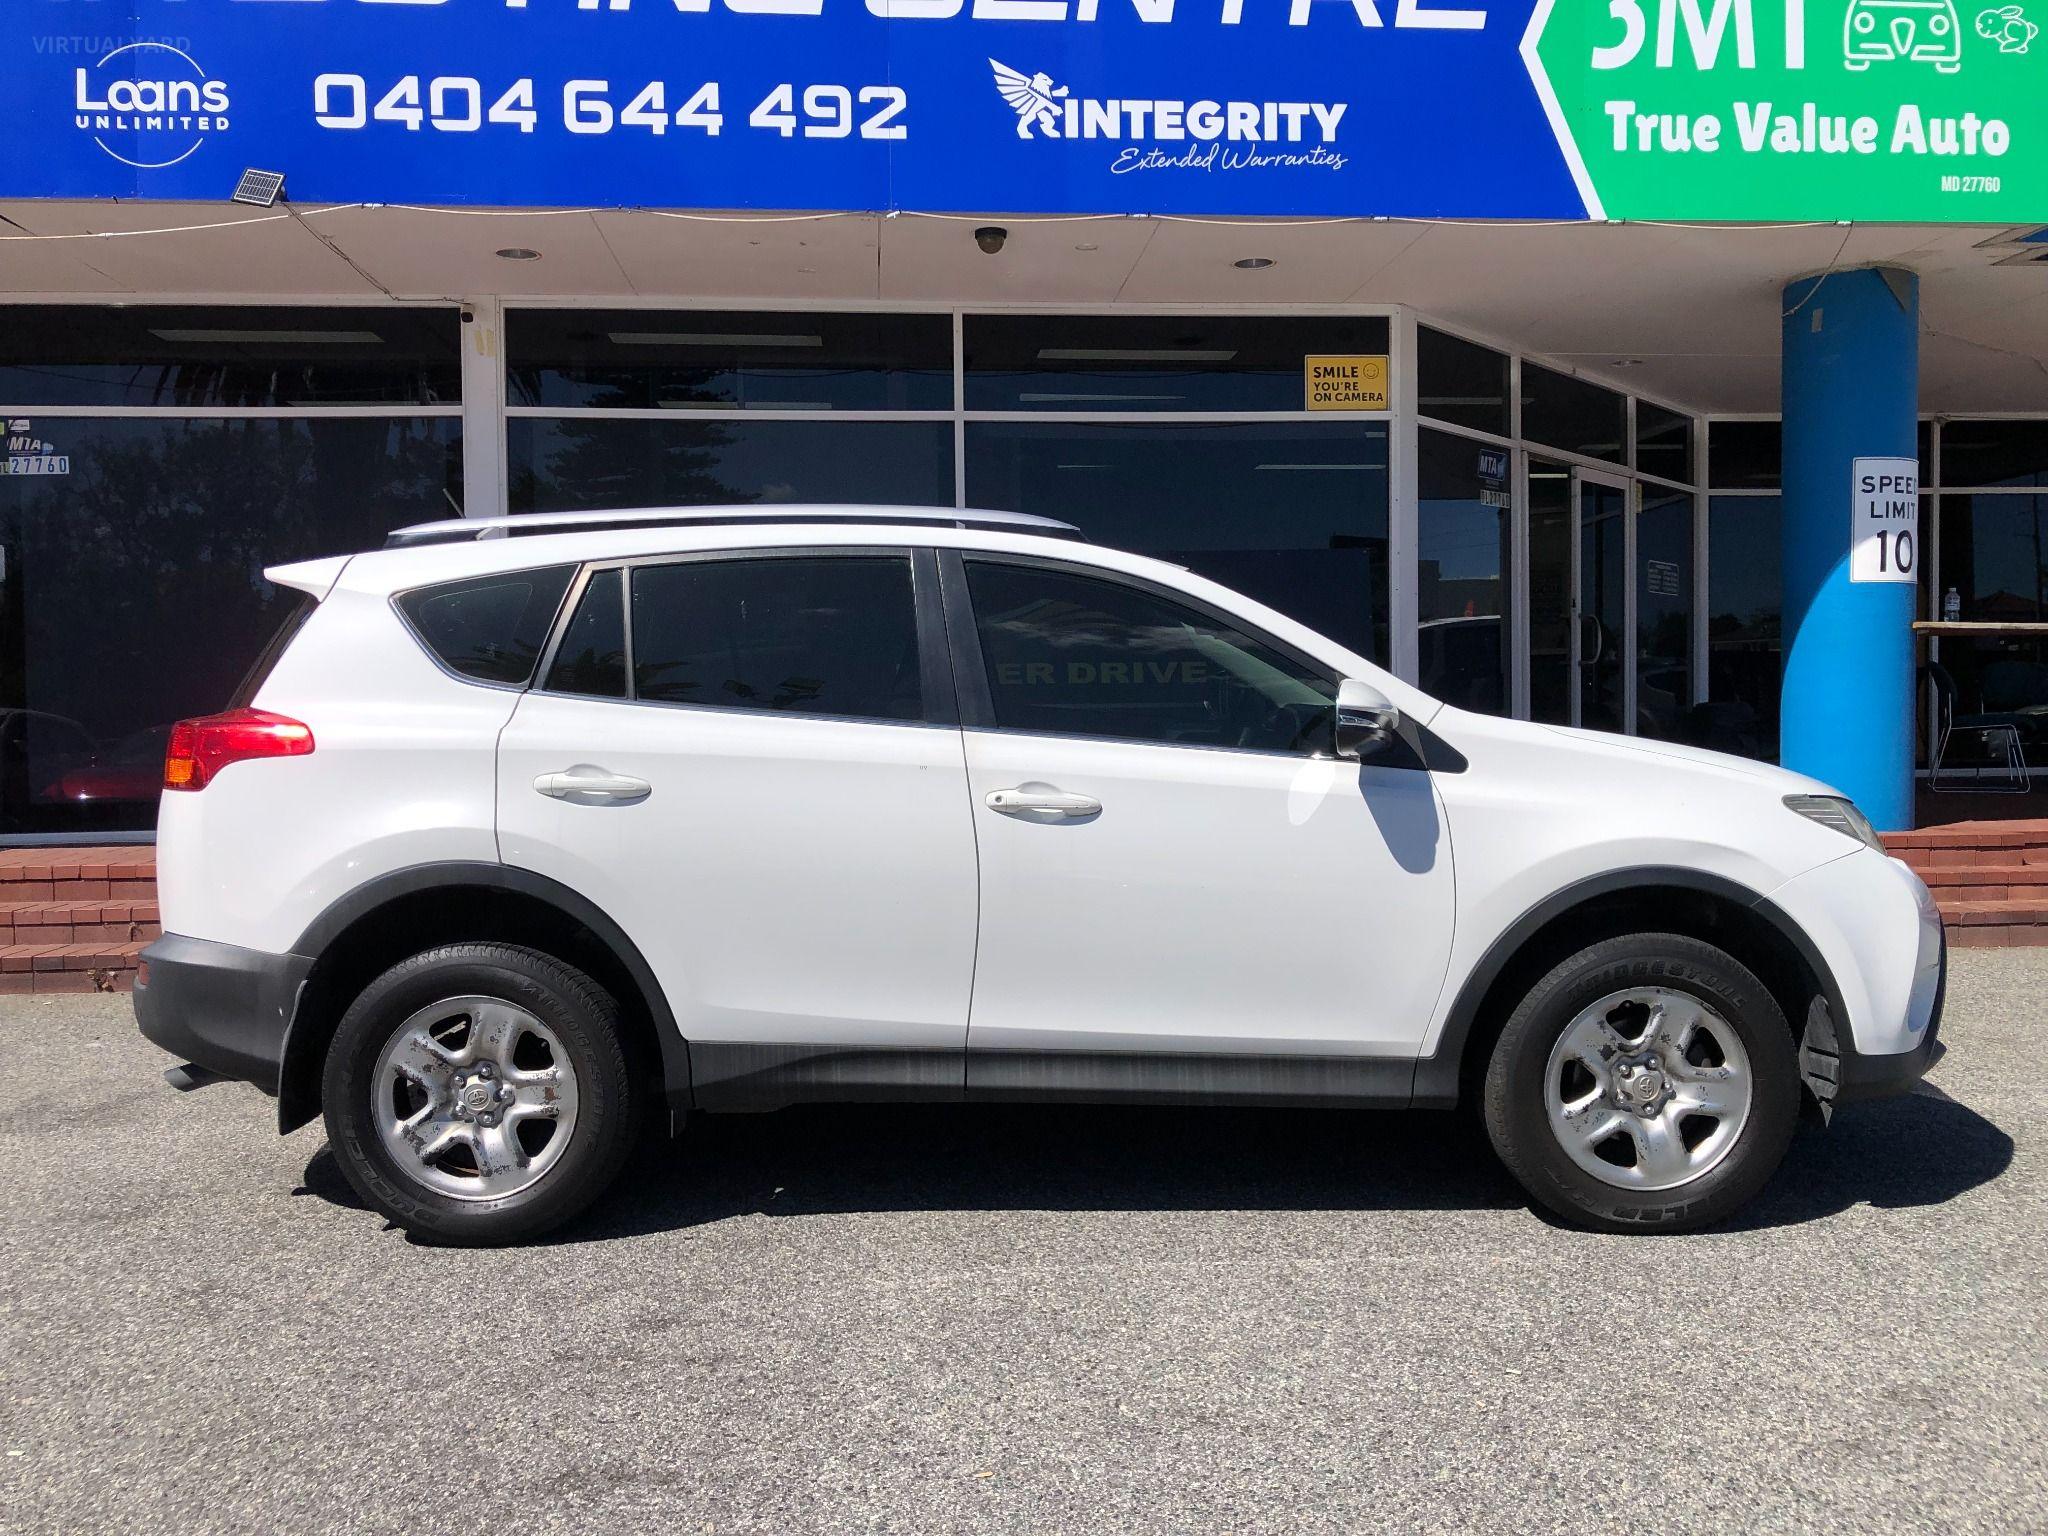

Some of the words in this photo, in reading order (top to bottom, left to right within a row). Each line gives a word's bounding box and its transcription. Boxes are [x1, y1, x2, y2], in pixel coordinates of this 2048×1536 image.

[76, 68, 230, 113] Loans
[315, 73, 536, 133] 0404
[563, 80, 723, 136] 644
[749, 84, 907, 140] 492
[75, 115, 230, 131] UNLIMITED
[1065, 98, 1348, 142] INTEGRITY
[1605, 100, 1721, 153] True
[1733, 102, 1880, 154] Value
[1890, 104, 2011, 156] Auto
[1111, 142, 1220, 174] Extended
[1221, 143, 1349, 170] Warranties
[1941, 175, 1960, 191] MD
[1962, 176, 2001, 192] 27760
[1313, 366, 1359, 378] SMILE
[1313, 381, 1359, 391] YOU'RE
[1313, 392, 1332, 402] ON
[1334, 392, 1384, 402] CAMERA
[9, 436, 42, 451] MTA
[11, 457, 68, 474] 27760
[1479, 454, 1498, 475] MTA
[1870, 500, 1916, 520] LIMIT
[1876, 529, 1914, 574] 10
[1066, 661, 1209, 684] DRIVE
